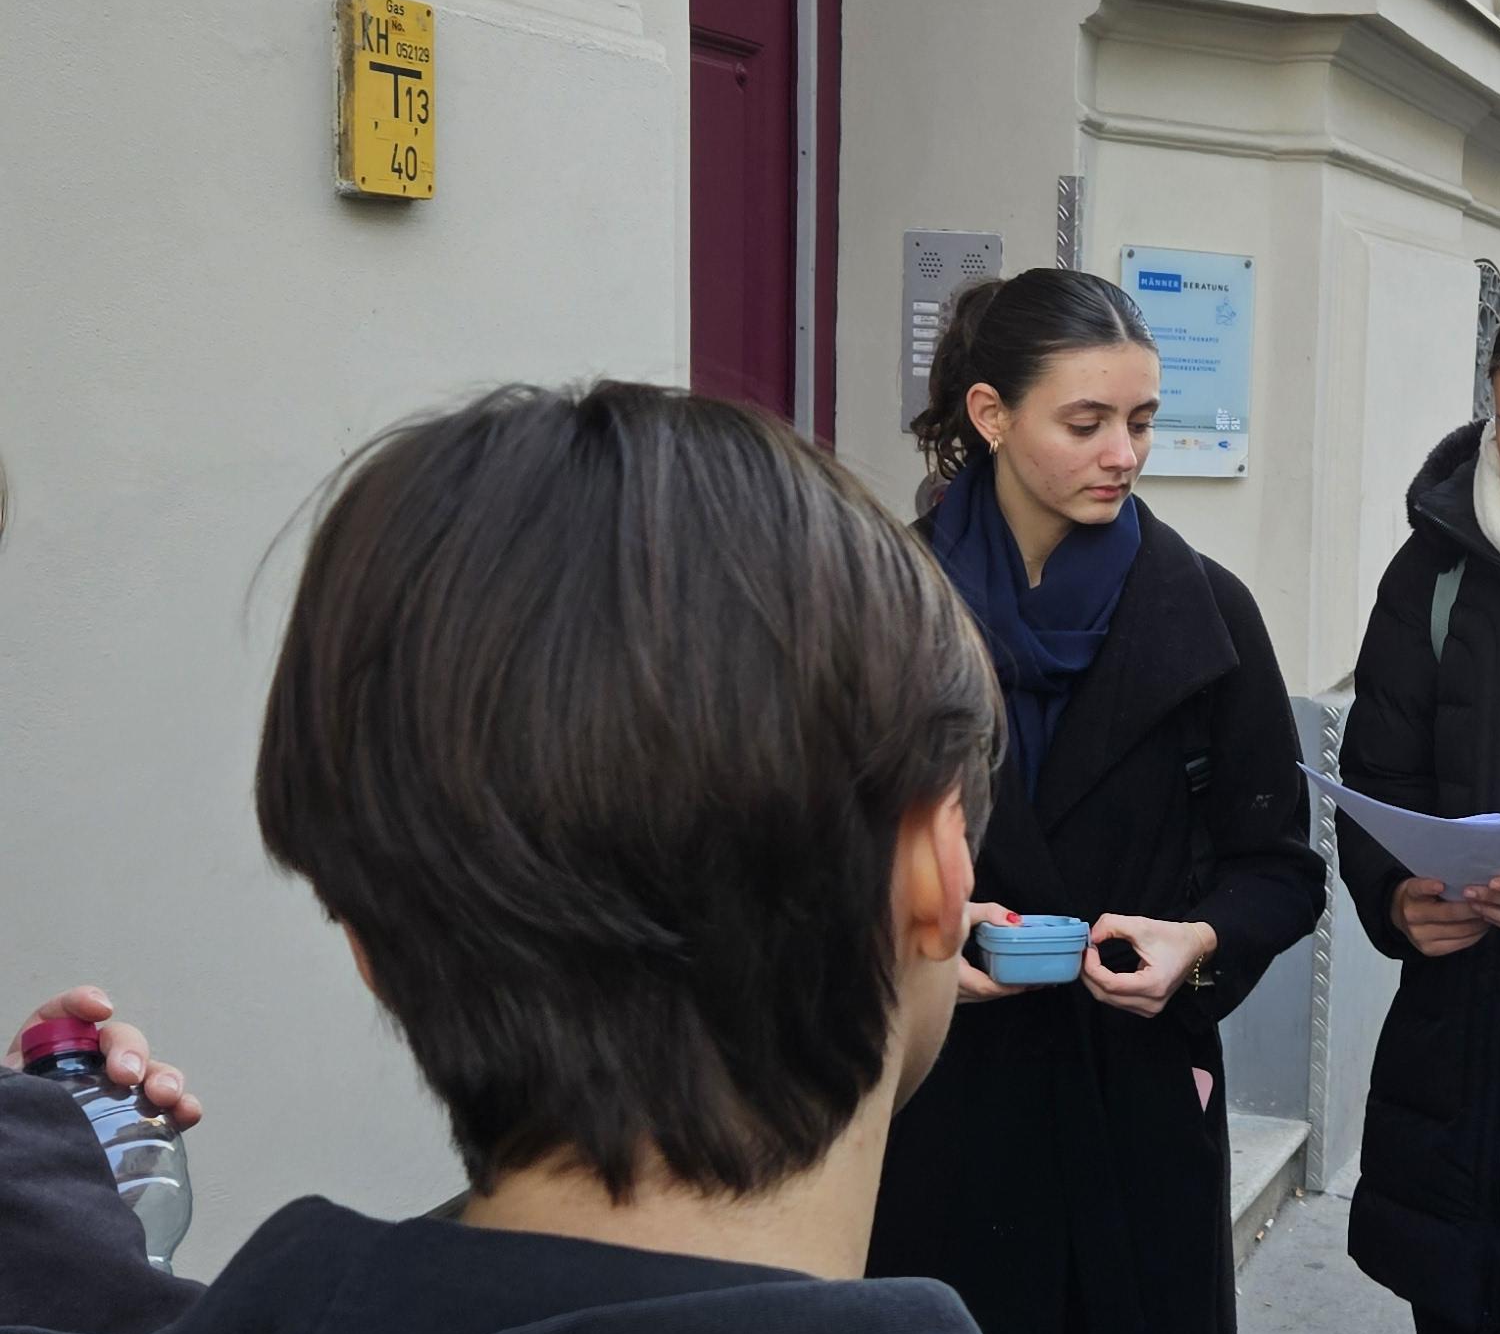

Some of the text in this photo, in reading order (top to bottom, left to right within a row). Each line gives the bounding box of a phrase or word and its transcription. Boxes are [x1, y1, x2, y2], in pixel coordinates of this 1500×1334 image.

[361, 12, 389, 56] KH
[396, 42, 430, 63] 052129
[405, 86, 429, 124] 13
[391, 143, 418, 181] 40
